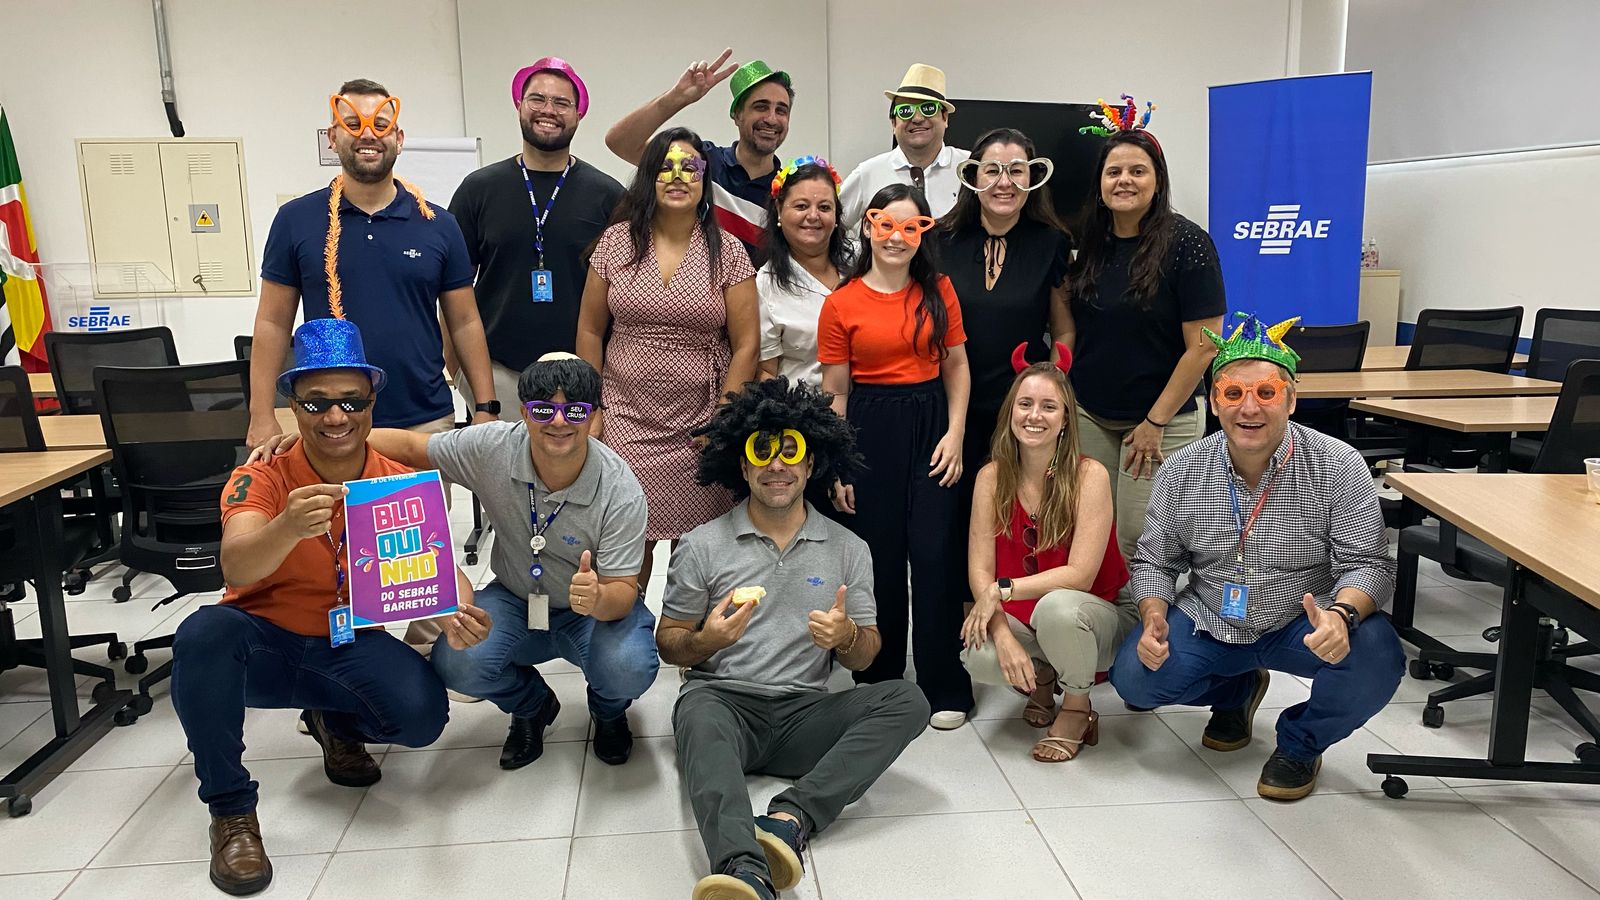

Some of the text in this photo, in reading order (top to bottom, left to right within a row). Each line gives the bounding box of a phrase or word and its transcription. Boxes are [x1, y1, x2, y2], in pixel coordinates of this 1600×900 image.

[1233, 220, 1331, 239] SEBRAE
[68, 315, 131, 328] SEBRAE
[226, 474, 253, 505] 3
[372, 497, 425, 532] BLO
[376, 526, 423, 560] QUI
[379, 552, 438, 588] NHO
[380, 584, 439, 602] DO SEBRAE
[383, 597, 438, 613] BARRETOS
